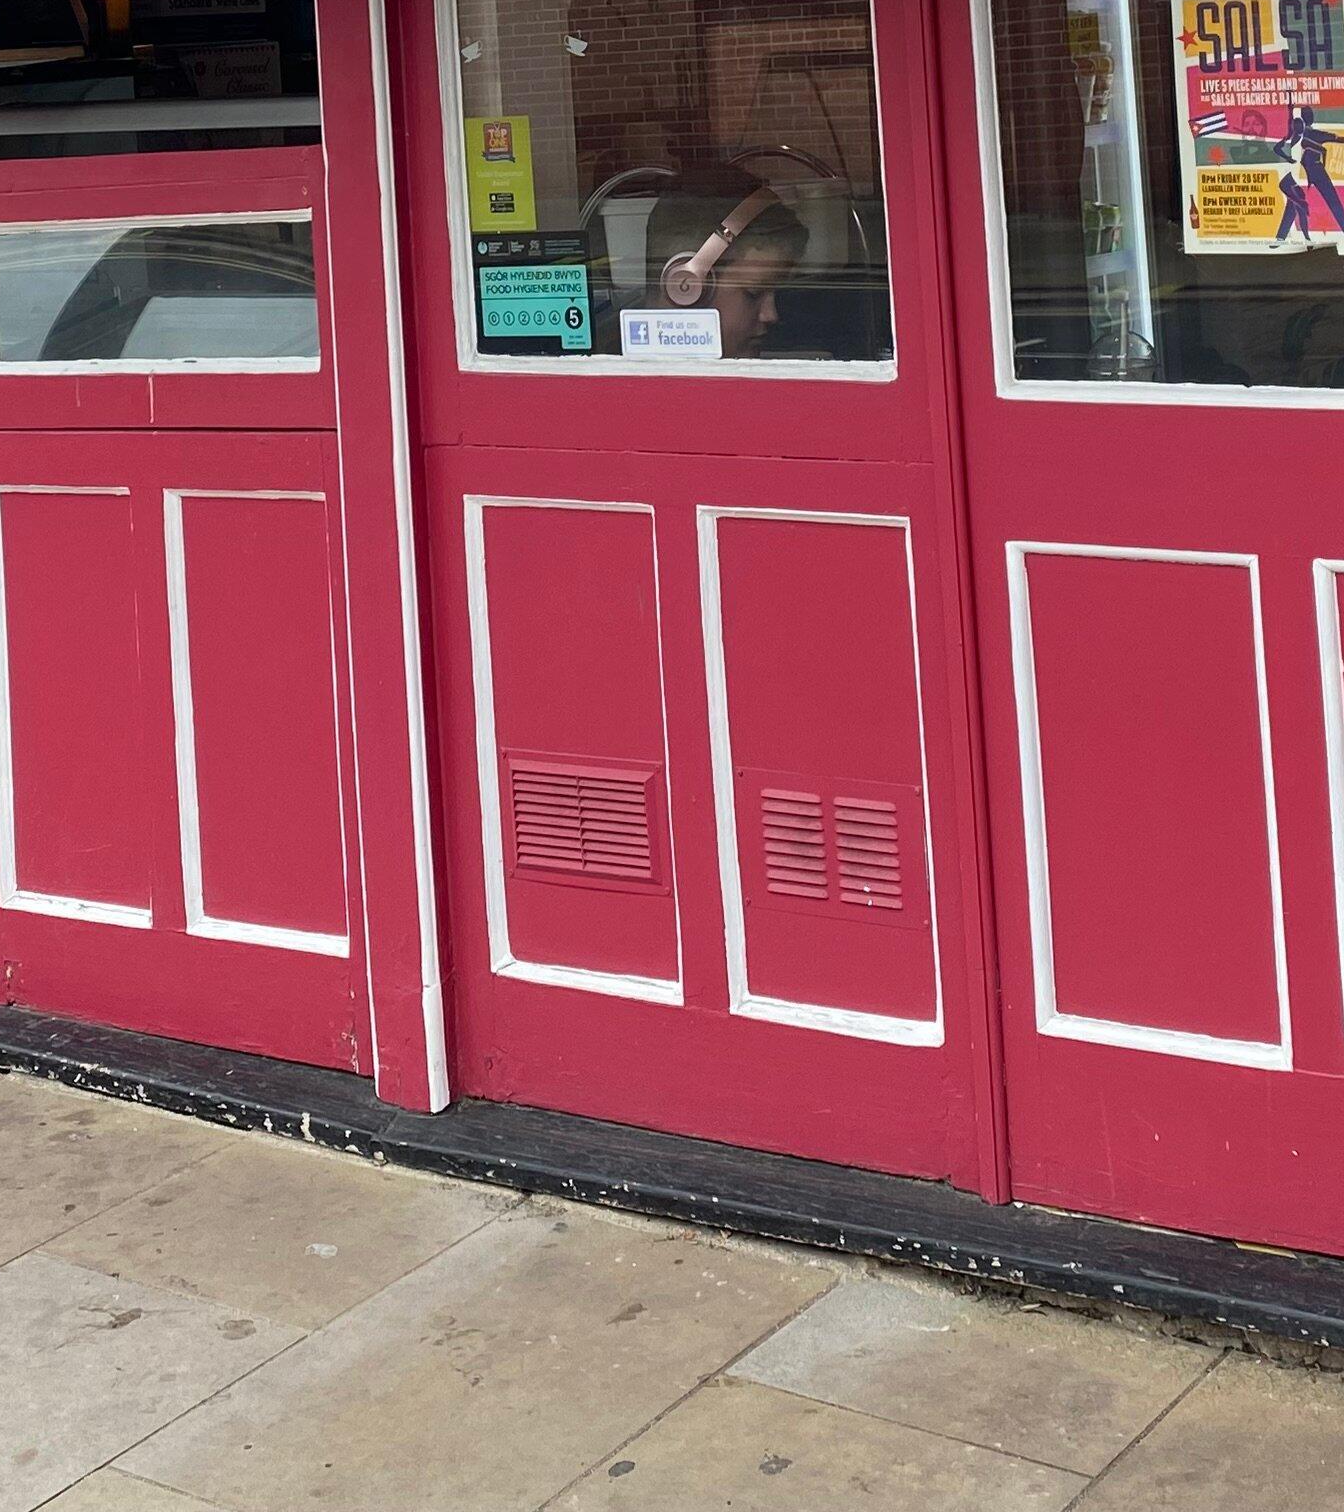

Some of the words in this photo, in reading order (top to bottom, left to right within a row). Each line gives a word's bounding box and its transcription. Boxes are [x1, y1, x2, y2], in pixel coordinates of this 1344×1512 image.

[1200, 78, 1220, 93] LIVE
[1221, 79, 1227, 92] 5
[1229, 78, 1250, 92] PIECE
[1252, 78, 1275, 91] SALSA
[1276, 77, 1298, 91] BAND
[1211, 93, 1236, 107] SALSA
[1237, 92, 1271, 106] TEACHER
[1279, 92, 1289, 105] DJ
[1291, 91, 1320, 105] MARTIN
[1217, 174, 1240, 184] FRIDAY
[1253, 173, 1269, 183] SEPT
[510, 271, 552, 281] HYLENDID
[554, 270, 582, 280] BWYD
[486, 284, 511, 294] FOOD
[513, 284, 550, 294] HYGIENE
[551, 283, 582, 293] RATING
[569, 310, 579, 327] 5
[656, 321, 674, 329] Find
[658, 331, 713, 345] facebook
